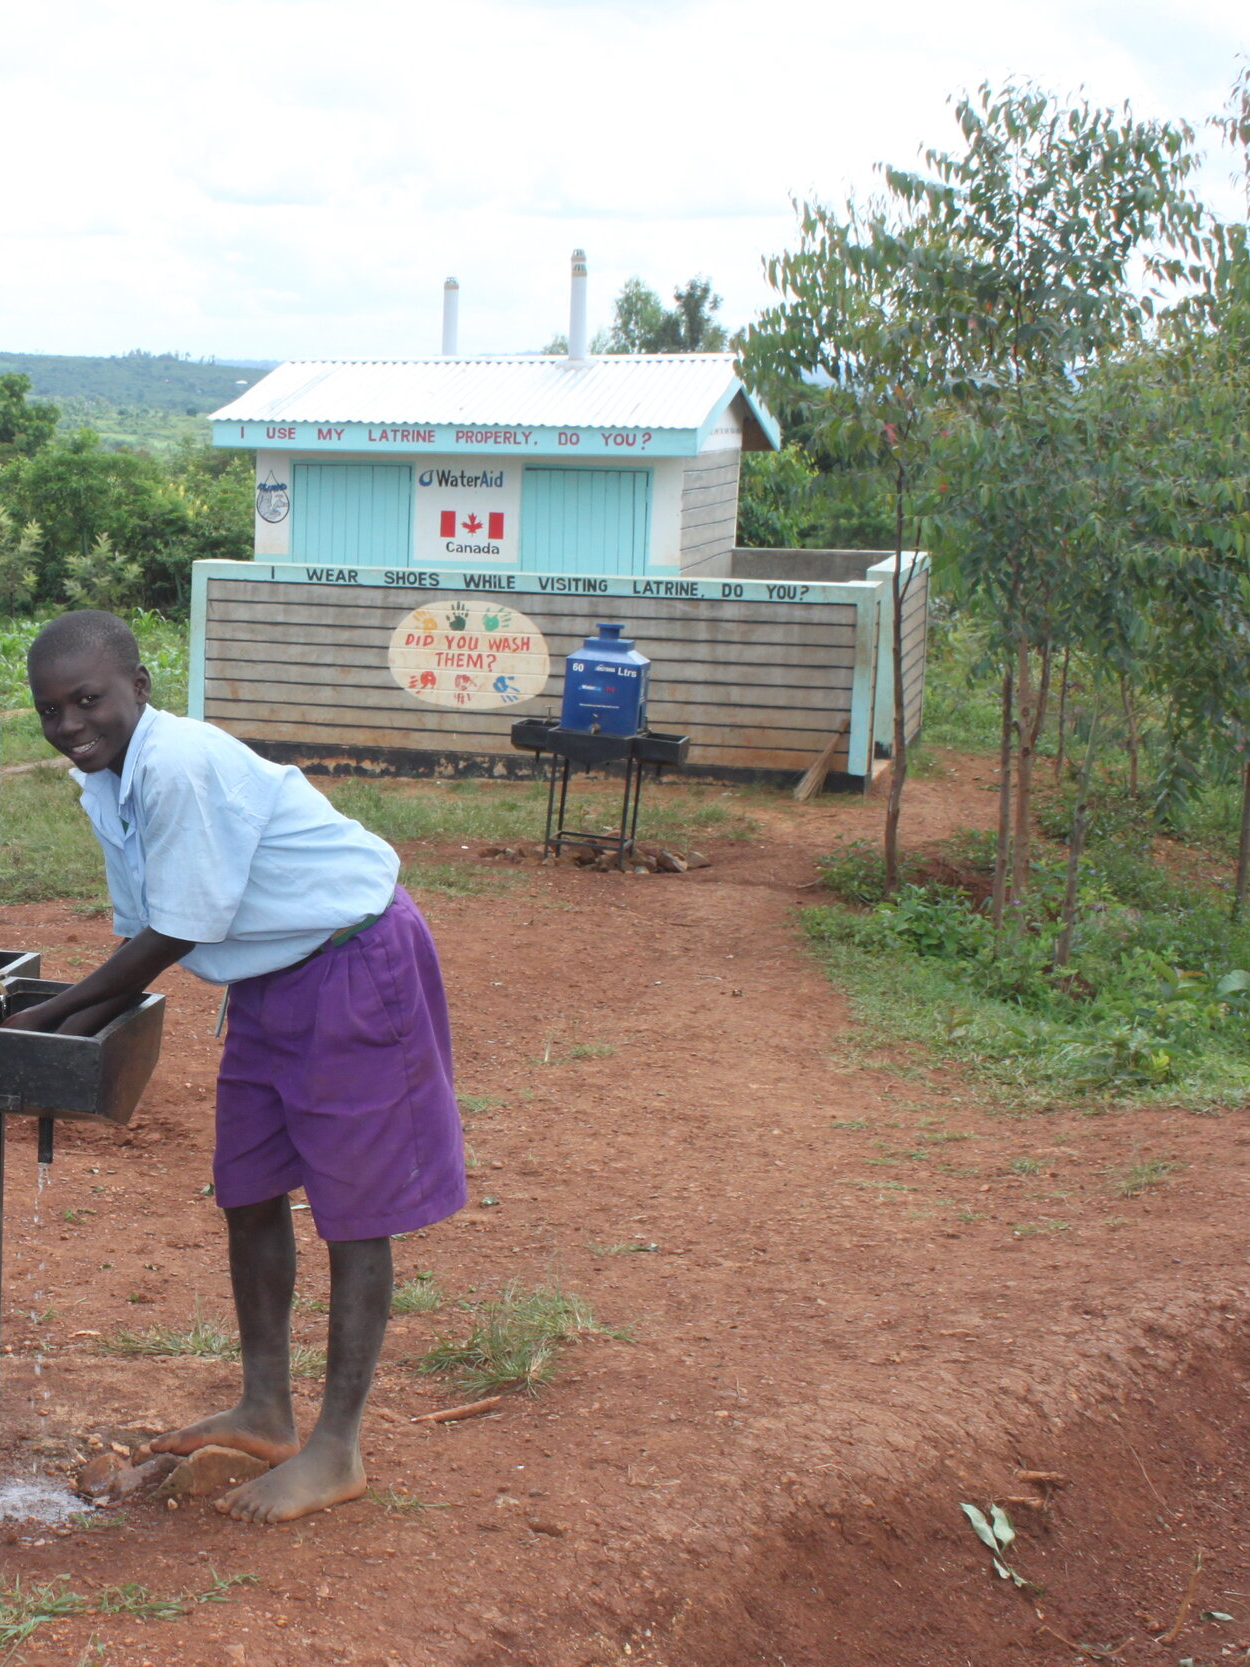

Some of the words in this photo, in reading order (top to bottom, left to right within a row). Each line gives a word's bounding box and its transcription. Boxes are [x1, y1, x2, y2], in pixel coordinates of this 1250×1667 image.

[240, 426, 245, 439] I
[266, 427, 296, 440] USE
[317, 428, 345, 441] MY
[368, 429, 436, 443] LATRINE
[455, 430, 538, 446] PROPERLY,
[558, 432, 580, 446] DO
[601, 432, 652, 450] YOU?
[436, 469, 503, 488] WaterAid
[446, 541, 500, 555] Canada
[270, 566, 275, 580] I
[306, 568, 358, 583] WEAR
[384, 571, 440, 587] SHOES
[538, 577, 608, 592] VISITING
[633, 580, 705, 598] LATRINE,
[721, 583, 744, 598] DO
[766, 585, 809, 601] YOU?
[405, 633, 435, 647] DID
[445, 635, 479, 650] YOU
[488, 637, 530, 652] WASH
[435, 652, 497, 672] THEM?
[572, 662, 584, 672] 60
[617, 667, 637, 678] Ltrs
